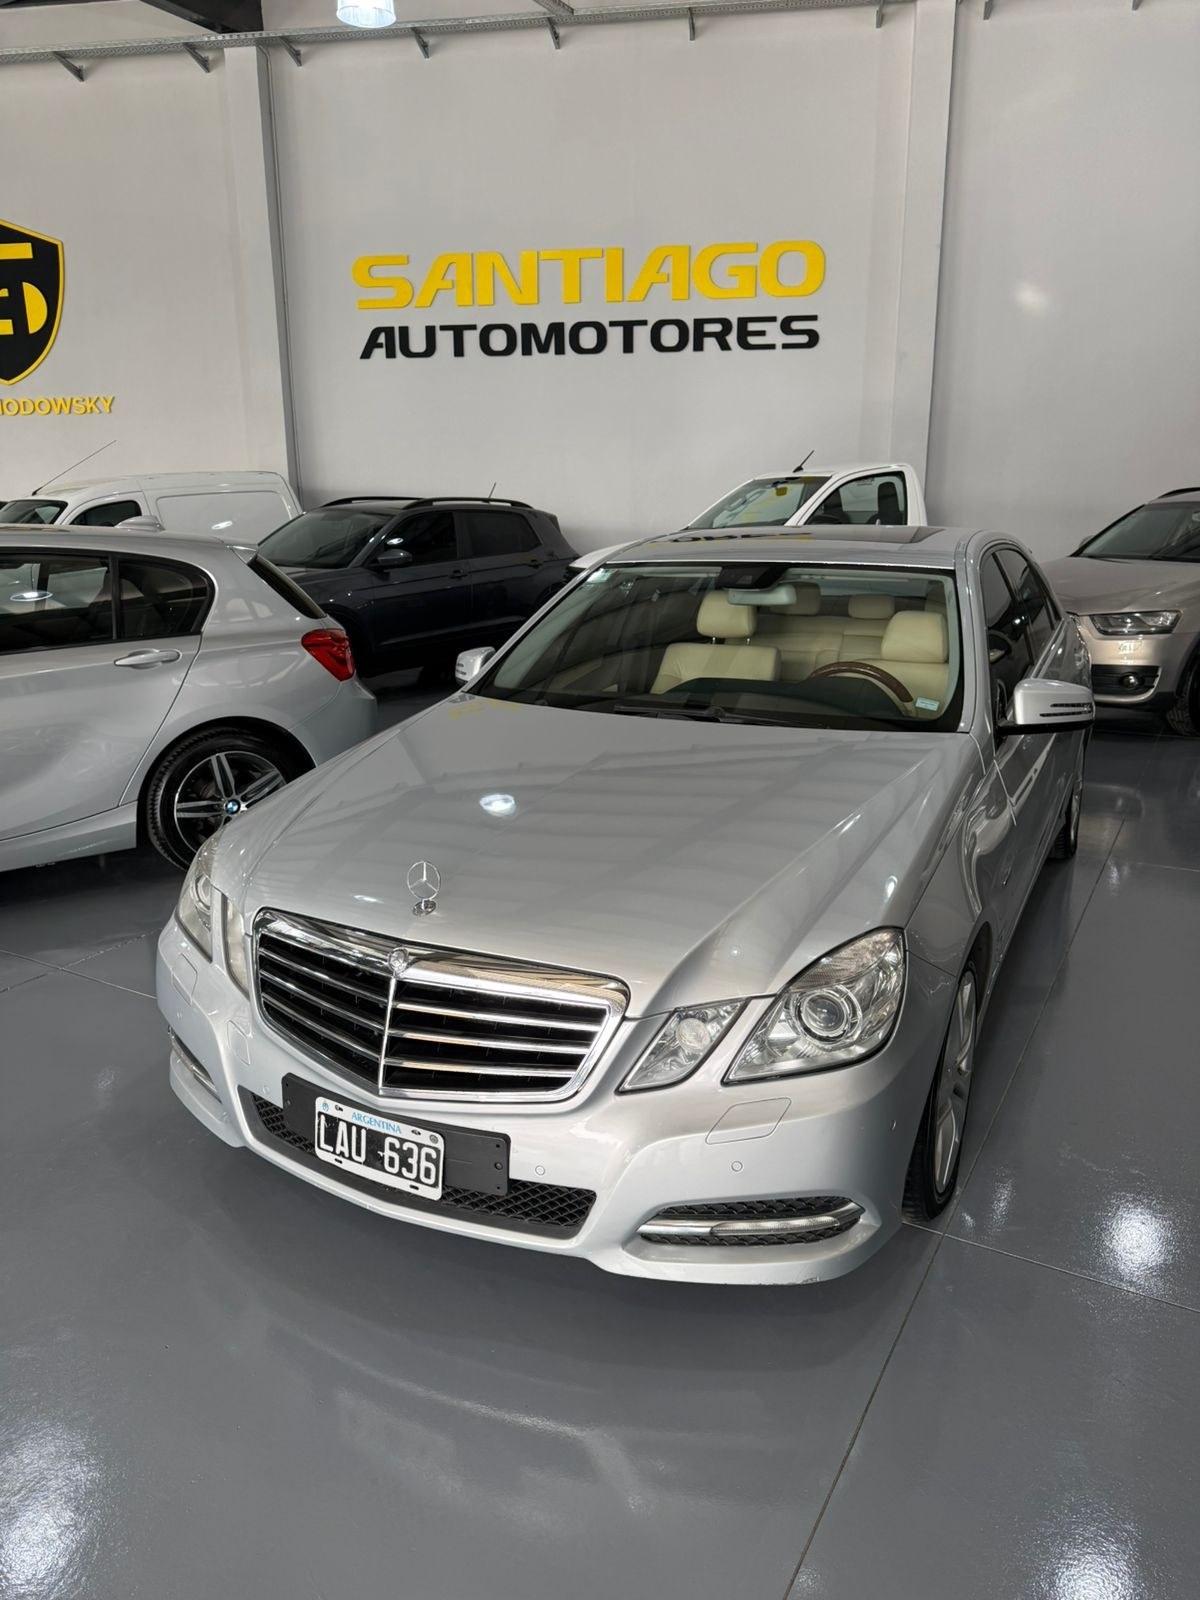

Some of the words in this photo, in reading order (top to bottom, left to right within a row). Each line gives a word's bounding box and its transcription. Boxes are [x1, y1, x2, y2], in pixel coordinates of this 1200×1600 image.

[351, 240, 826, 309] SANTIAGO
[360, 315, 819, 360] AUTOMOTORES
[0, 396, 115, 416] ODOWSKY
[351, 1111, 402, 1134] ARGENTINA
[318, 1114, 367, 1163] LAU
[384, 1136, 437, 1186] 636
